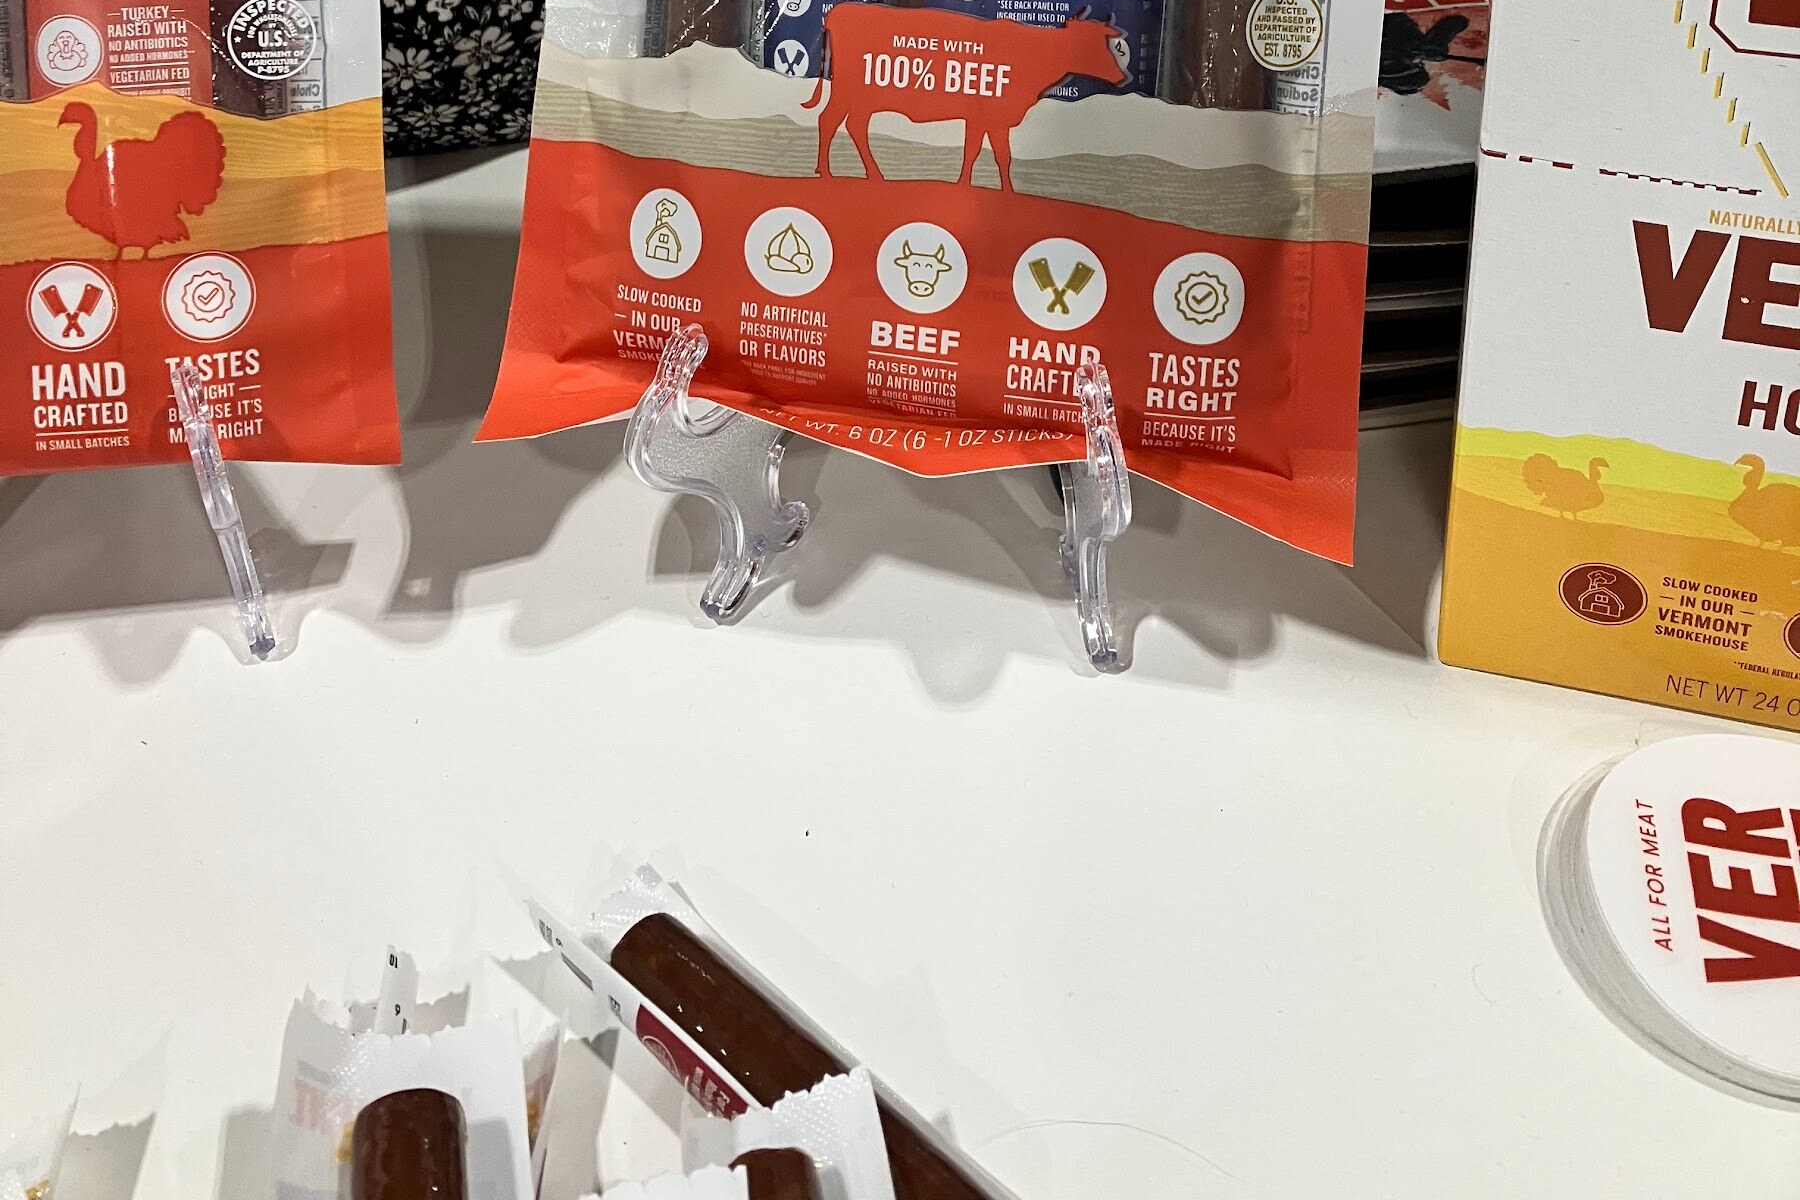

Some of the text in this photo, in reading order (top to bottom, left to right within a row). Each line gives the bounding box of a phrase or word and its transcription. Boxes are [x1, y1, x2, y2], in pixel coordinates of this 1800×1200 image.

[121, 6, 169, 20] TURKEY
[1014, 0, 1070, 12] BACK PANEL FOR
[1264, 6, 1308, 15] INSPECTED
[107, 21, 187, 38] RAISED WITH
[1254, 24, 1304, 33] DEPARTMENT
[1257, 15, 1304, 24] AND PASSED
[109, 37, 188, 52] NO ANTIBIOTICS
[257, 30, 288, 47] U.S.
[893, 35, 984, 55] MADE WITH
[1257, 33, 1311, 43] AGRICULTURE
[1264, 42, 1302, 59] EST. 8795
[110, 67, 190, 84] VEGETARIAN FED
[863, 53, 1011, 98] 100% BEEF
[617, 284, 702, 313] SLOW COOKED
[631, 310, 681, 334] IN OUR
[741, 302, 829, 328] NO ARTIFICIAL
[870, 320, 961, 356] BEEF
[739, 339, 827, 368] OR FLAVORS
[1008, 337, 1100, 367] HAND
[31, 361, 127, 401] HAND
[867, 359, 957, 381] RAISED WITH
[1149, 352, 1241, 388] TASTES
[867, 371, 957, 397] NO ANTIBIOTICS
[237, 398, 263, 415] IT'S
[911, 393, 957, 409] HORMONES
[1146, 387, 1237, 412] RIGHT
[33, 401, 128, 429] CRAFTED
[1003, 402, 1049, 420] IN SMALL
[217, 418, 263, 440] RIGHT
[805, 420, 987, 451] WT. 6 OZ (6 OZ
[1142, 420, 1236, 442] BECAUSE IT'S
[36, 435, 130, 451] IN SMALL BATCHES
[1662, 576, 1758, 603] SLOW COOKED
[1679, 595, 1734, 616] IN OUR
[1657, 606, 1752, 637] VERMONT
[1655, 624, 1749, 651] SMOKEHOUSE
[1666, 674, 1779, 713] NET WT 24
[1635, 798, 1674, 953] ALL FOR MEAT
